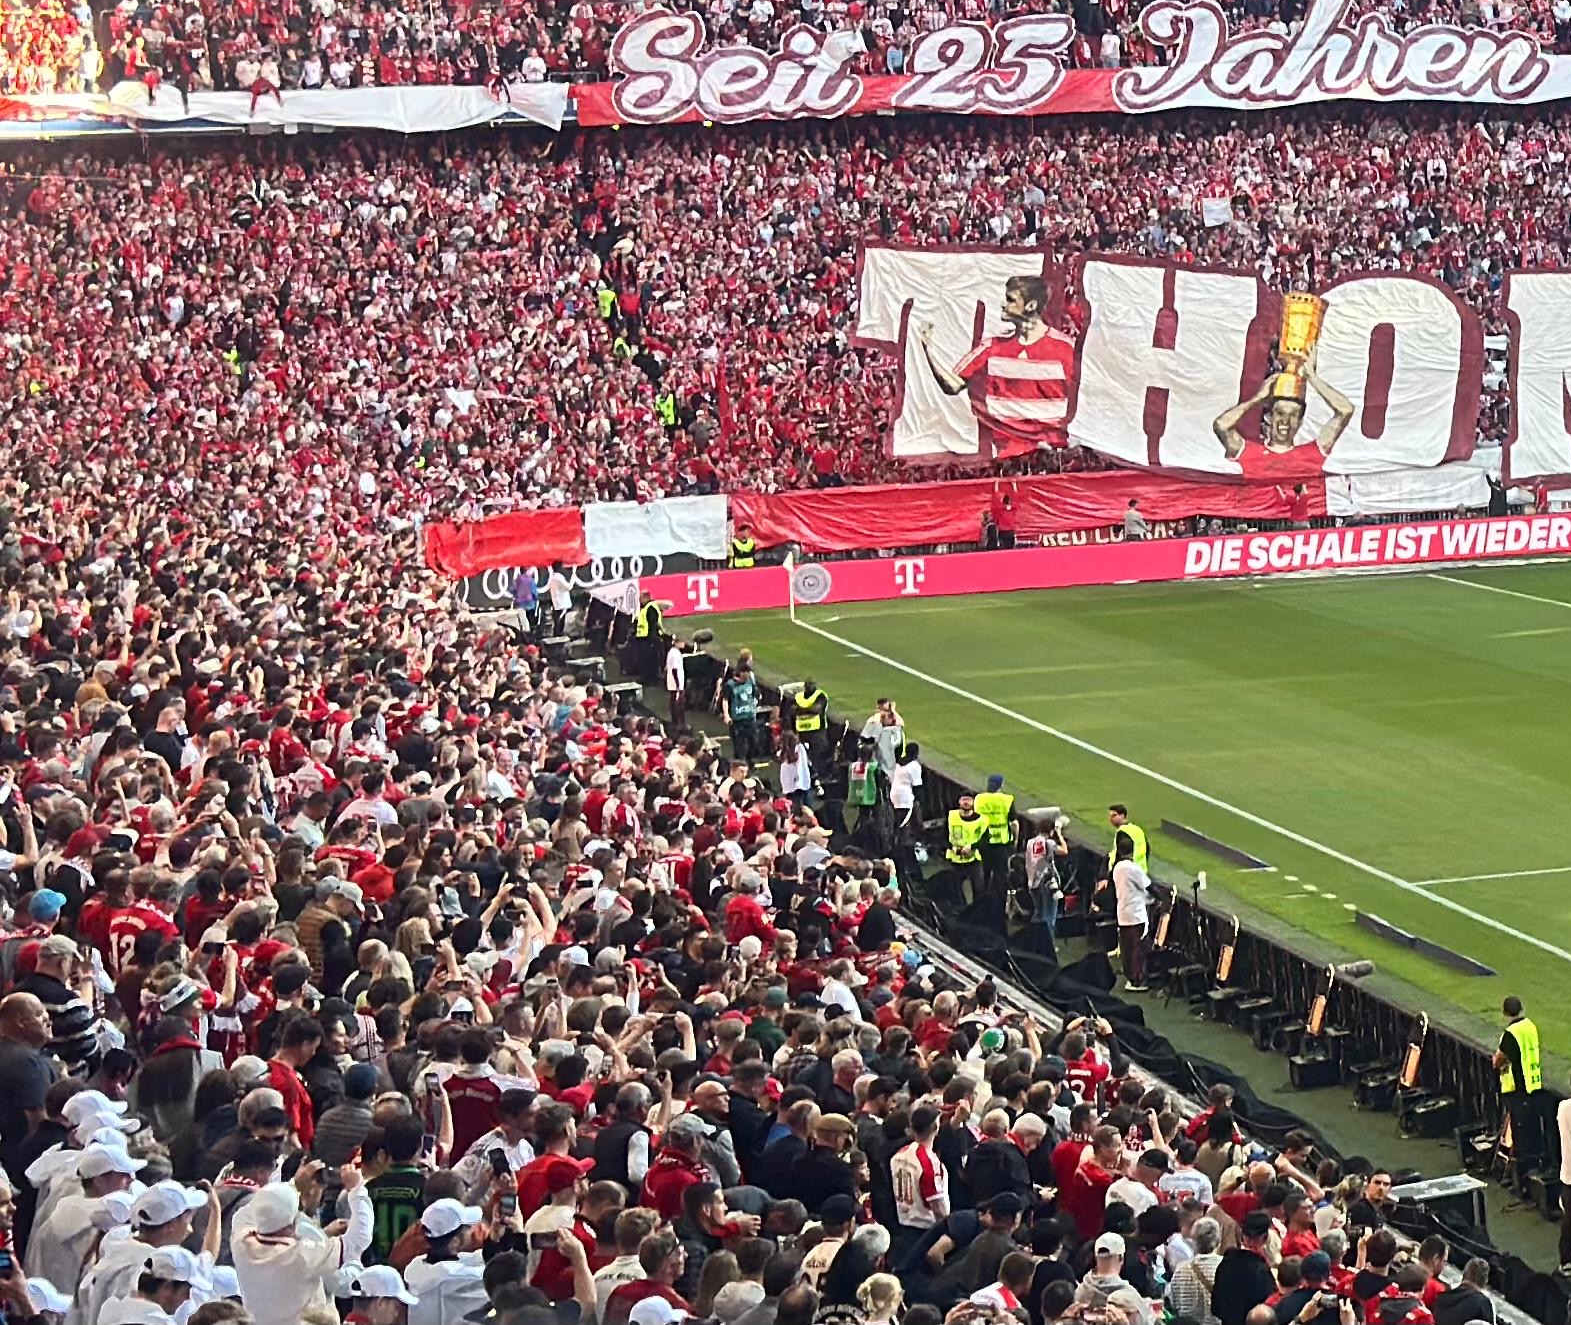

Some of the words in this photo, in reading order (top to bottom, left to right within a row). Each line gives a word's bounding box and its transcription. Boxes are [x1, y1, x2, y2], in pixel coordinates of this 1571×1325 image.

[612, 6, 866, 124] Seit
[893, 12, 1076, 115] 25
[1184, 539, 1244, 575] DIE
[1247, 529, 1382, 571] SCHALE
[1383, 524, 1439, 561] IST
[1440, 516, 1570, 557] WIEDER
